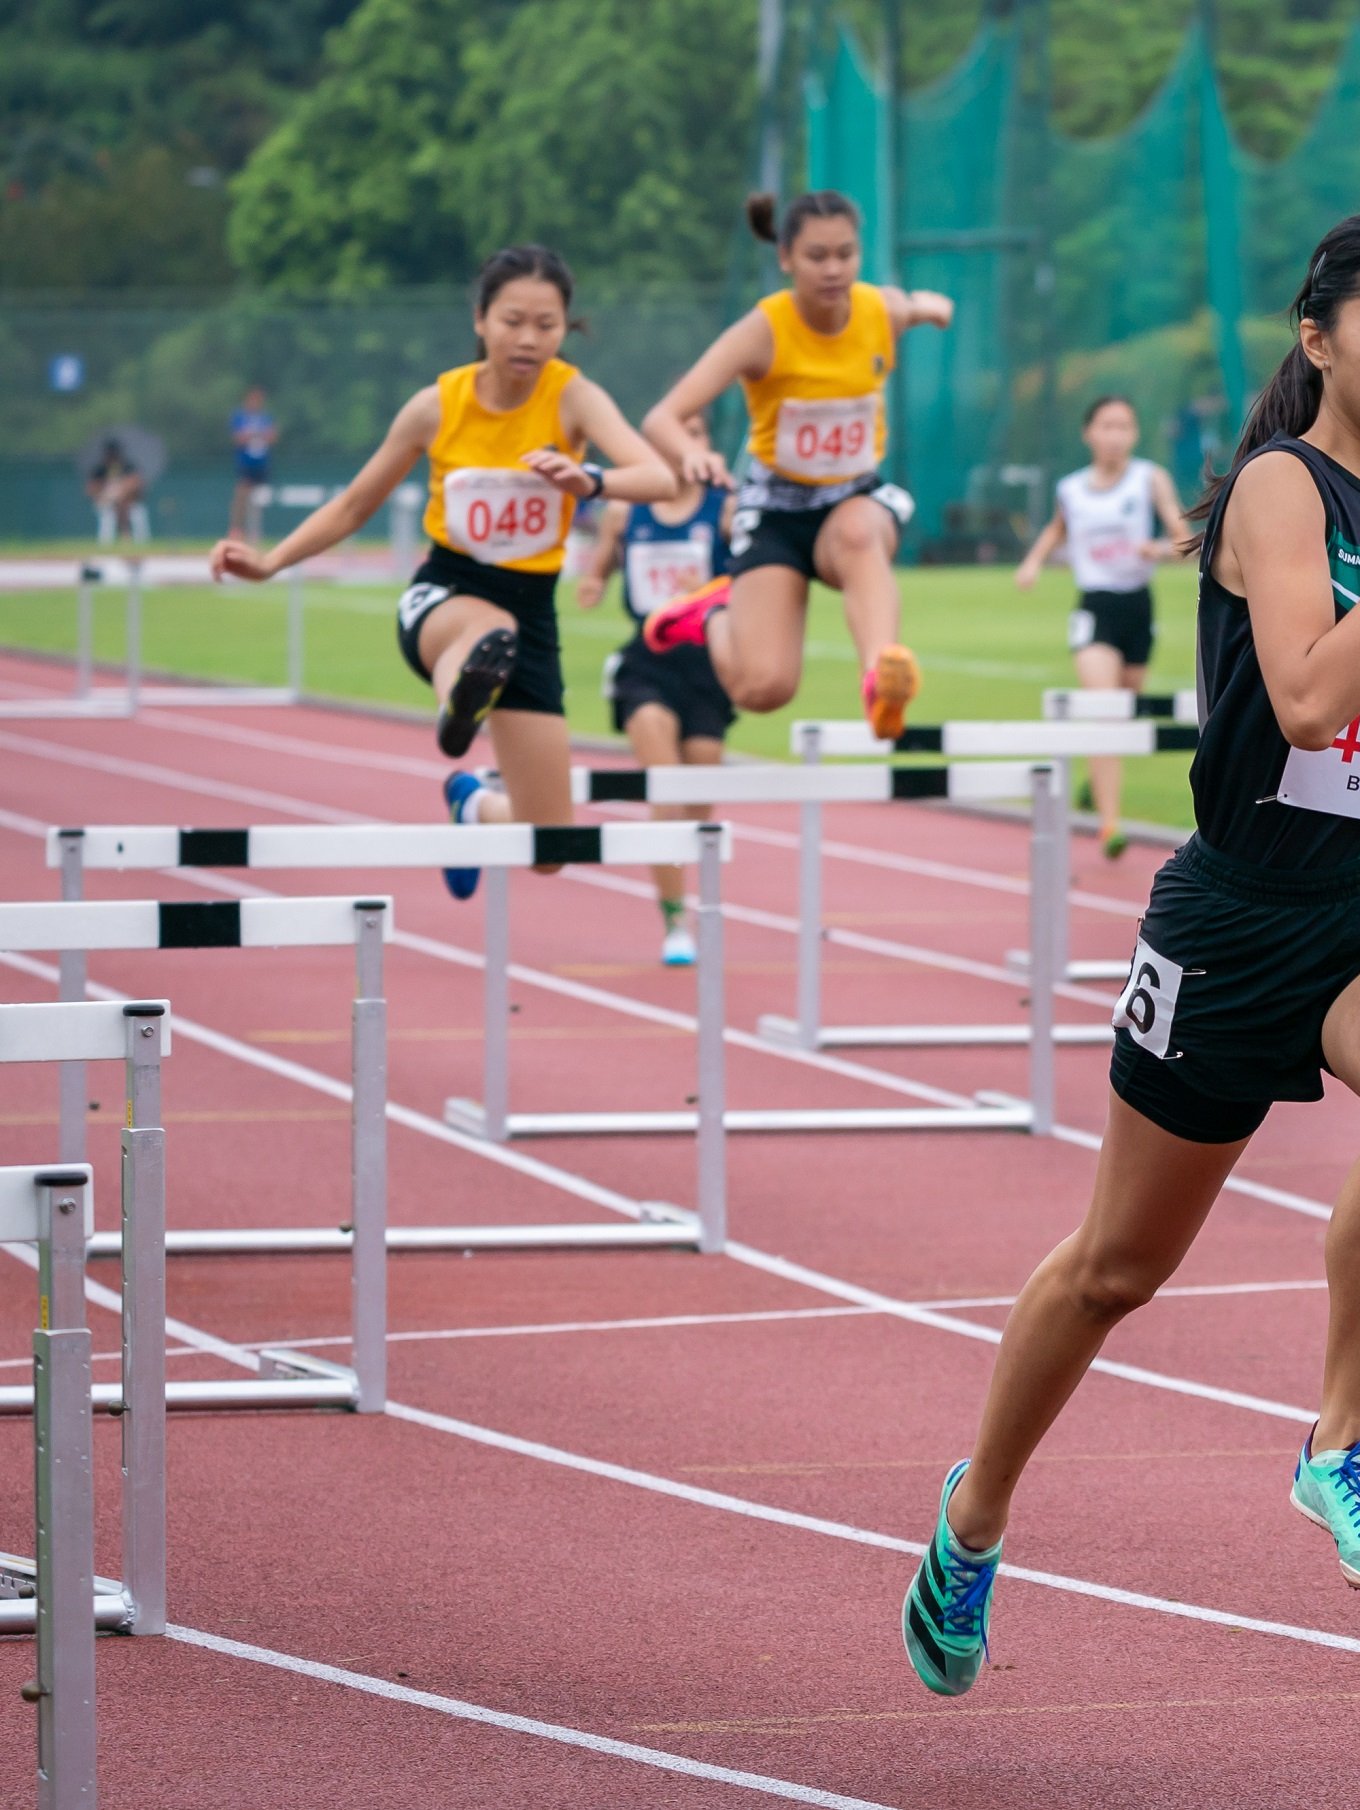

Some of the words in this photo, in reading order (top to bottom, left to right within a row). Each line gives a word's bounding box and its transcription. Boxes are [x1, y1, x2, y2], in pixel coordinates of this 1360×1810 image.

[795, 420, 866, 459] 049
[467, 498, 546, 542] 048
[1346, 775, 1360, 791] B
[1125, 962, 1161, 1034] 6
